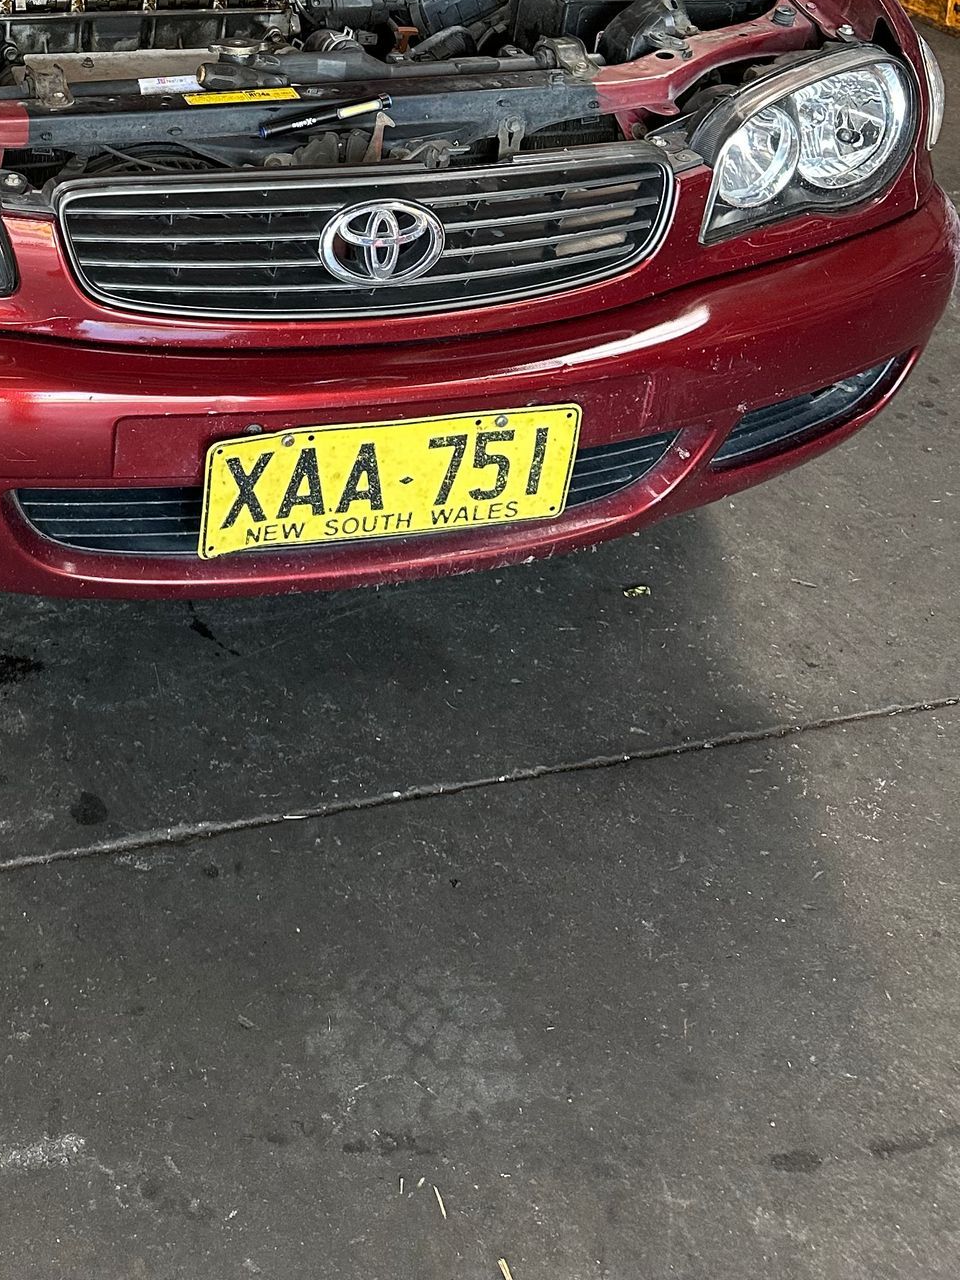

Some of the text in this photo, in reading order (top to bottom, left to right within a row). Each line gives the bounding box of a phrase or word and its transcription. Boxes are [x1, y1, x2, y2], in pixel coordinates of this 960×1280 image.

[245, 501, 519, 545] NEW SOUTH WALES
